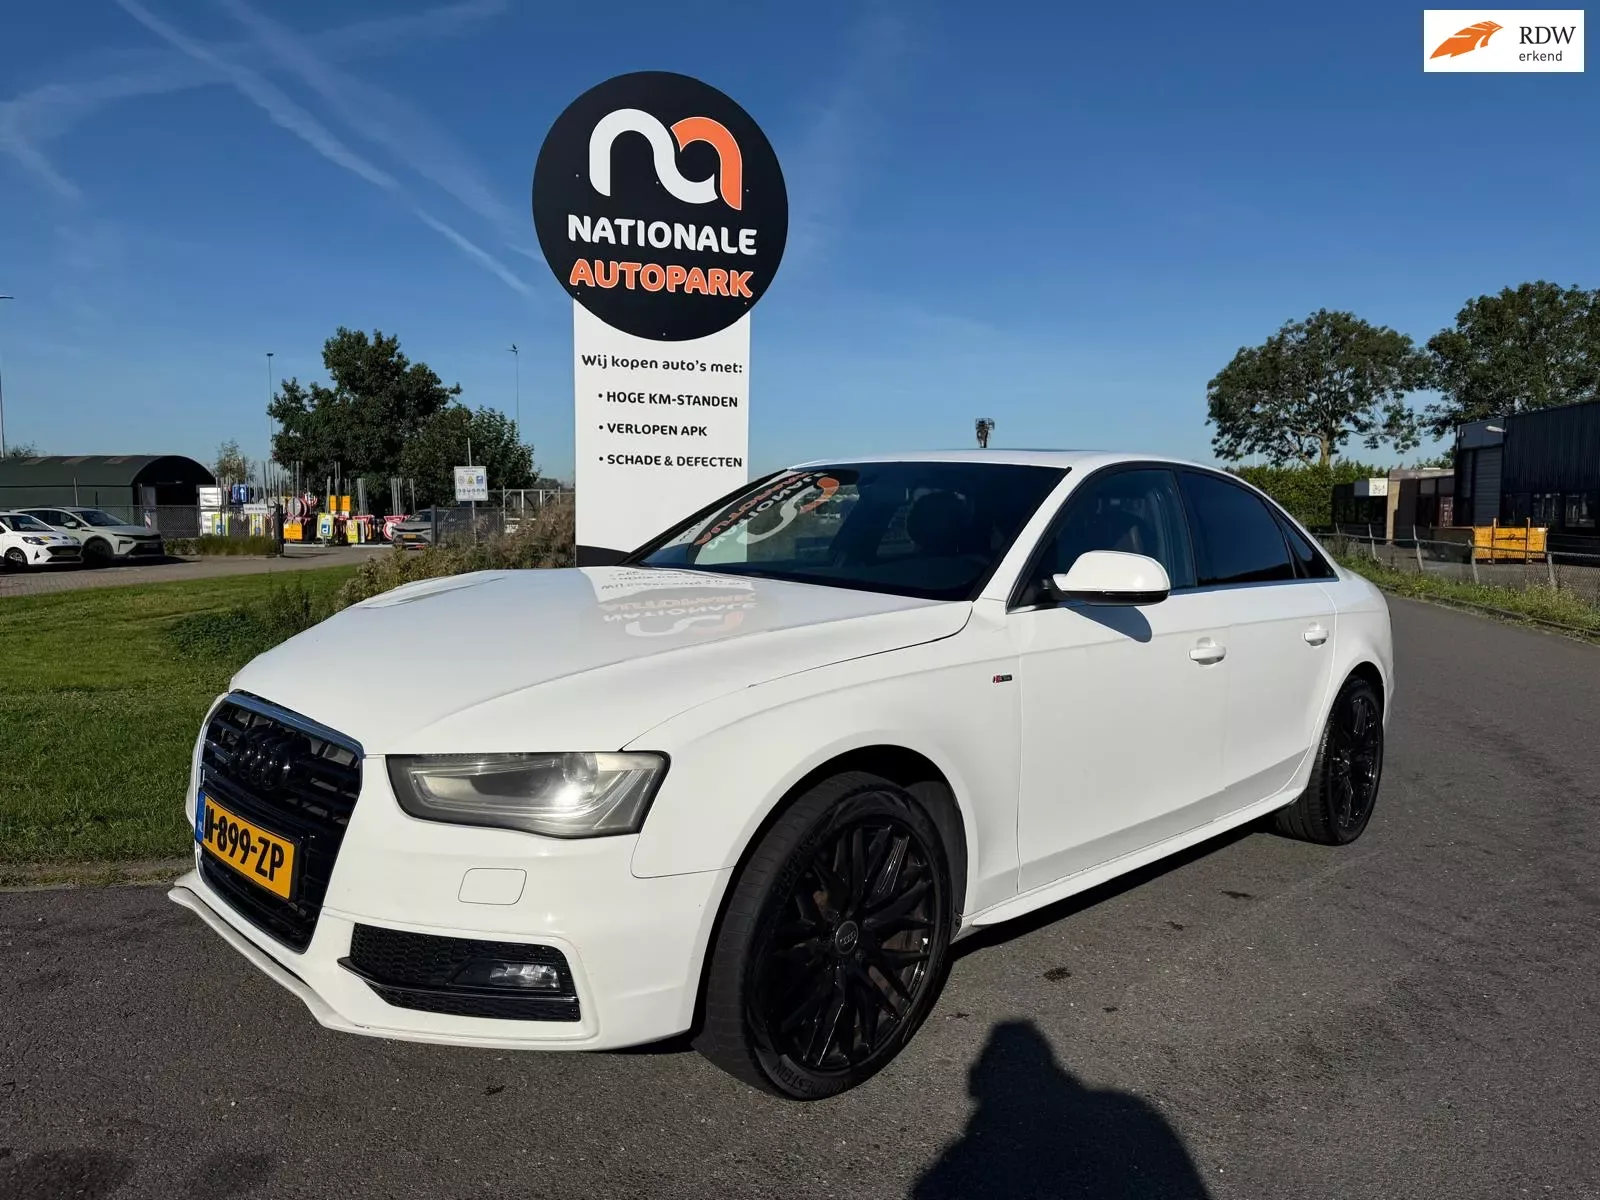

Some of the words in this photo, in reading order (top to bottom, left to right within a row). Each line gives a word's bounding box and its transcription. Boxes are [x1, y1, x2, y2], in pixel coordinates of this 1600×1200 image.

[567, 213, 758, 256] NATIONALE
[569, 258, 754, 298] AUTOPARK
[581, 354, 607, 370] Wij
[611, 355, 658, 371] kopen
[710, 362, 743, 374] met:
[606, 391, 645, 404] HOGE
[648, 393, 738, 408] KM-STANDEN
[606, 422, 678, 436] VERLOPEN
[680, 425, 708, 437] APK
[607, 454, 662, 466] SCHADE
[663, 455, 674, 467] &
[676, 456, 743, 468] DEFECTEN
